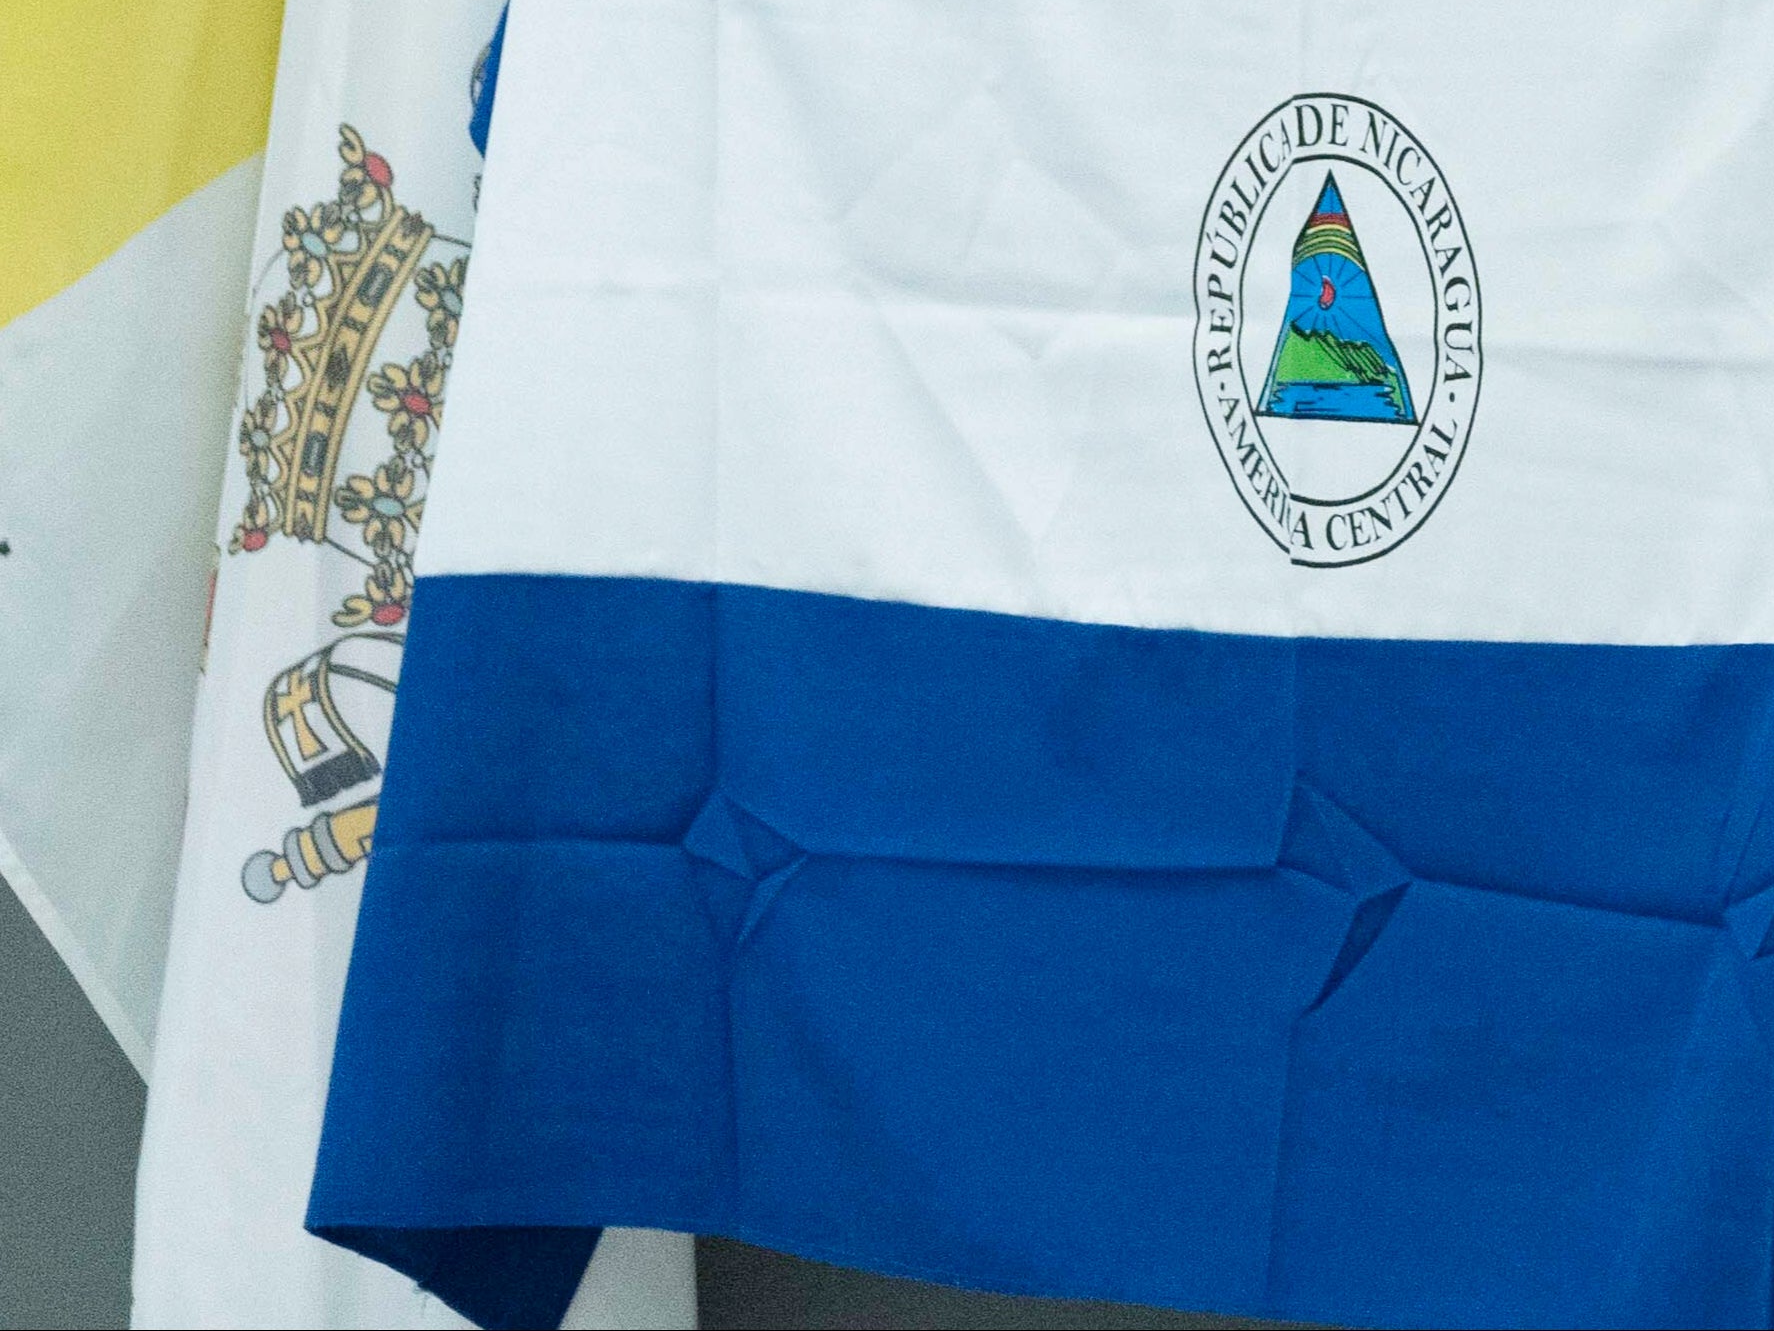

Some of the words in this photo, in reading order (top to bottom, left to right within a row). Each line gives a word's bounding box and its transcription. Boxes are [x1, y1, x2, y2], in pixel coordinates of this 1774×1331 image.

[1206, 118, 1292, 375] REPÚBLICA
[1294, 102, 1350, 148] DE
[1360, 110, 1474, 396] NICARAGUA
[1217, 394, 1314, 550] AMERIA
[1326, 417, 1458, 551] CENTRAL
